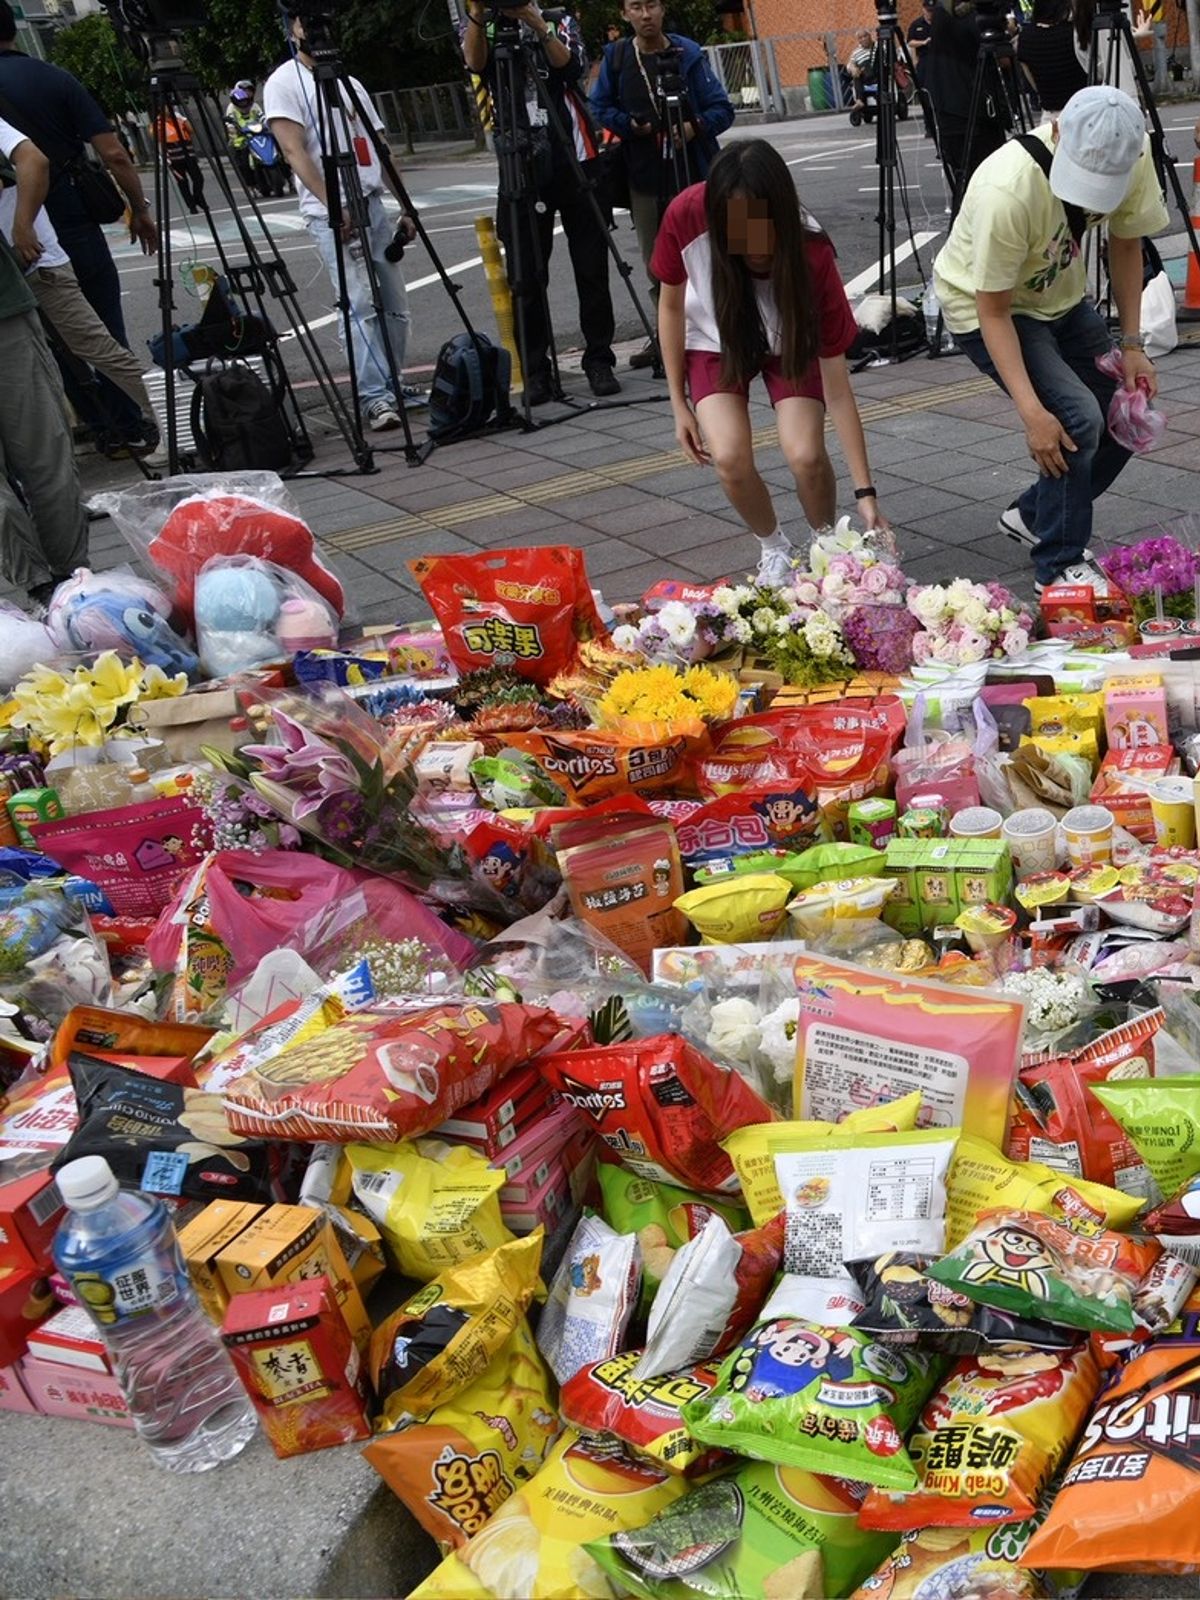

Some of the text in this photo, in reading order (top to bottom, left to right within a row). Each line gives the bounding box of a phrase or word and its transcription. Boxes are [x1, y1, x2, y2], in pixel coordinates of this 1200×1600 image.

[562, 1092, 626, 1110] Doritos
[136, 1109, 178, 1127] POTATO
[116, 1269, 147, 1289] 征服
[118, 1283, 151, 1302] 世界
[263, 1351, 311, 1381] 麥香
[799, 1412, 858, 1444] 造句包
[866, 1424, 901, 1448] 乖乖
[926, 1427, 1016, 1471] 螃蟹
[925, 1472, 1005, 1494] Crab King
[542, 1486, 620, 1522] 美國經典原味
